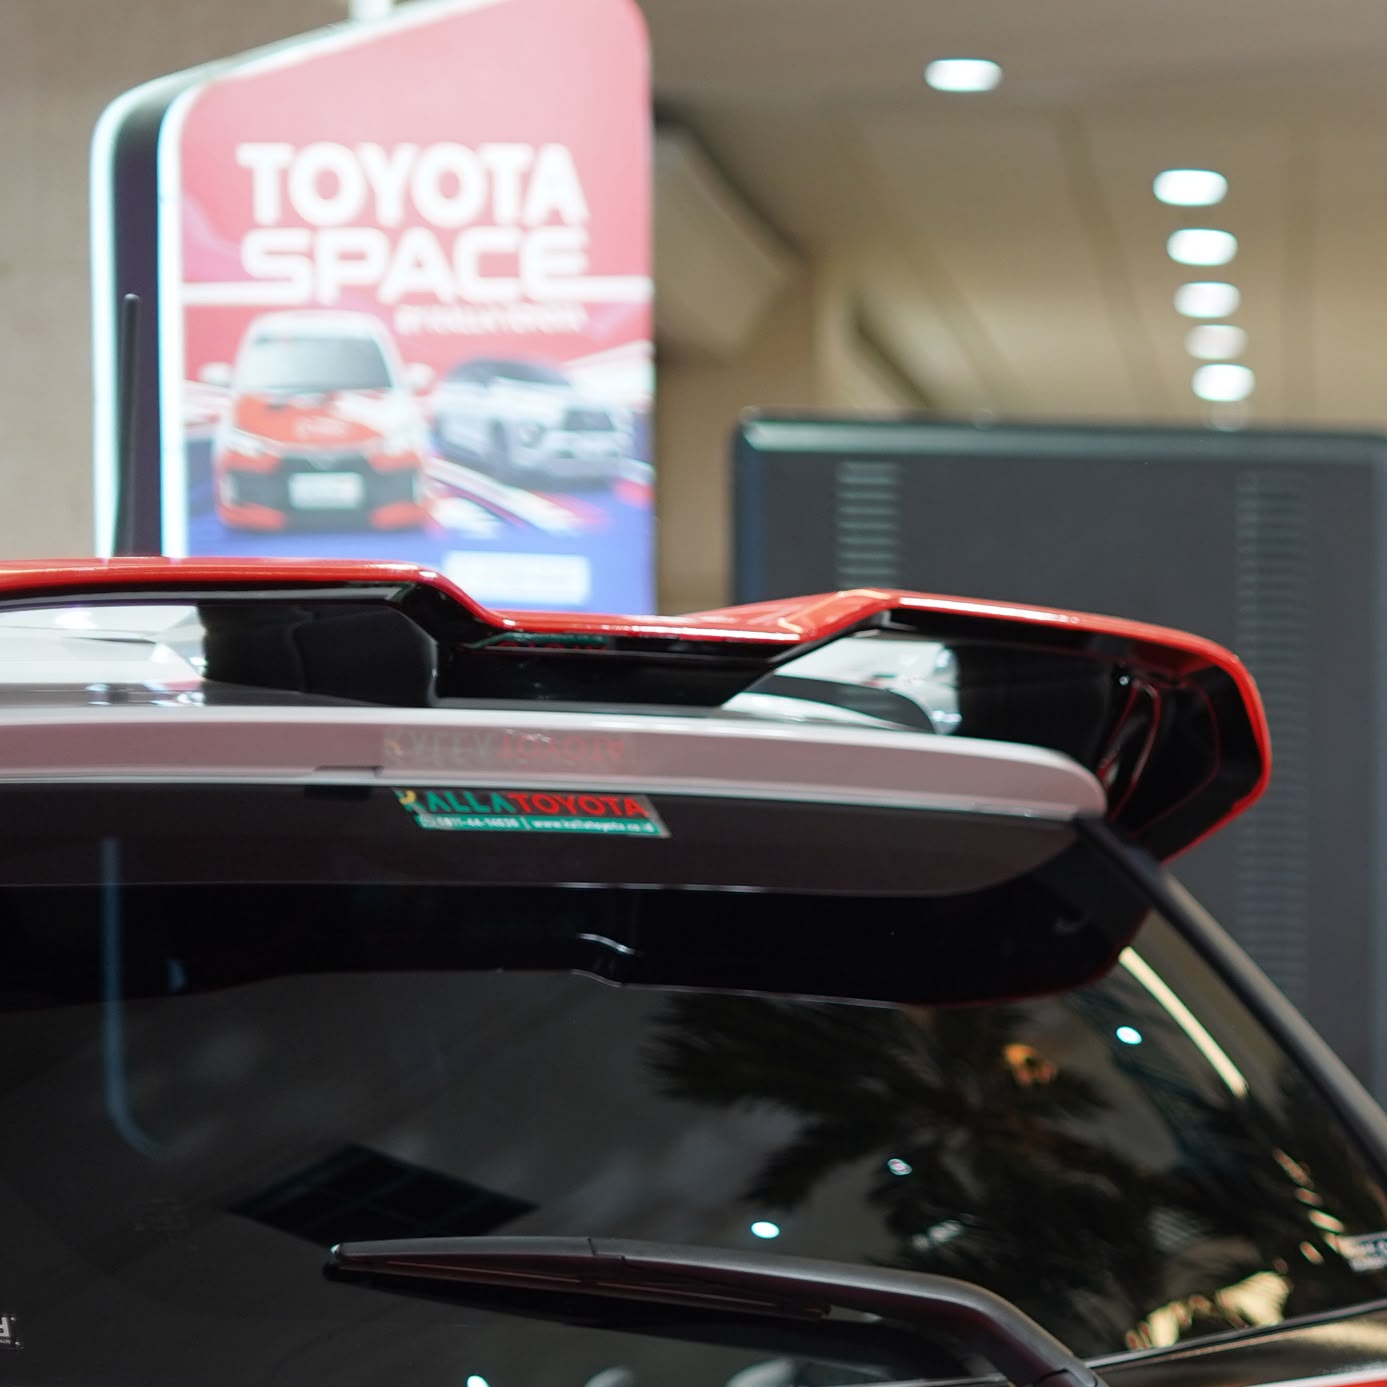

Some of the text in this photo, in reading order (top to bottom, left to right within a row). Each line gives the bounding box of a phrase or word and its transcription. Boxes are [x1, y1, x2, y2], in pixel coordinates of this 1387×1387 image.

[236, 141, 591, 228] TOYOTA
[240, 226, 590, 306] SPACE
[507, 791, 649, 818] TOYOTA
